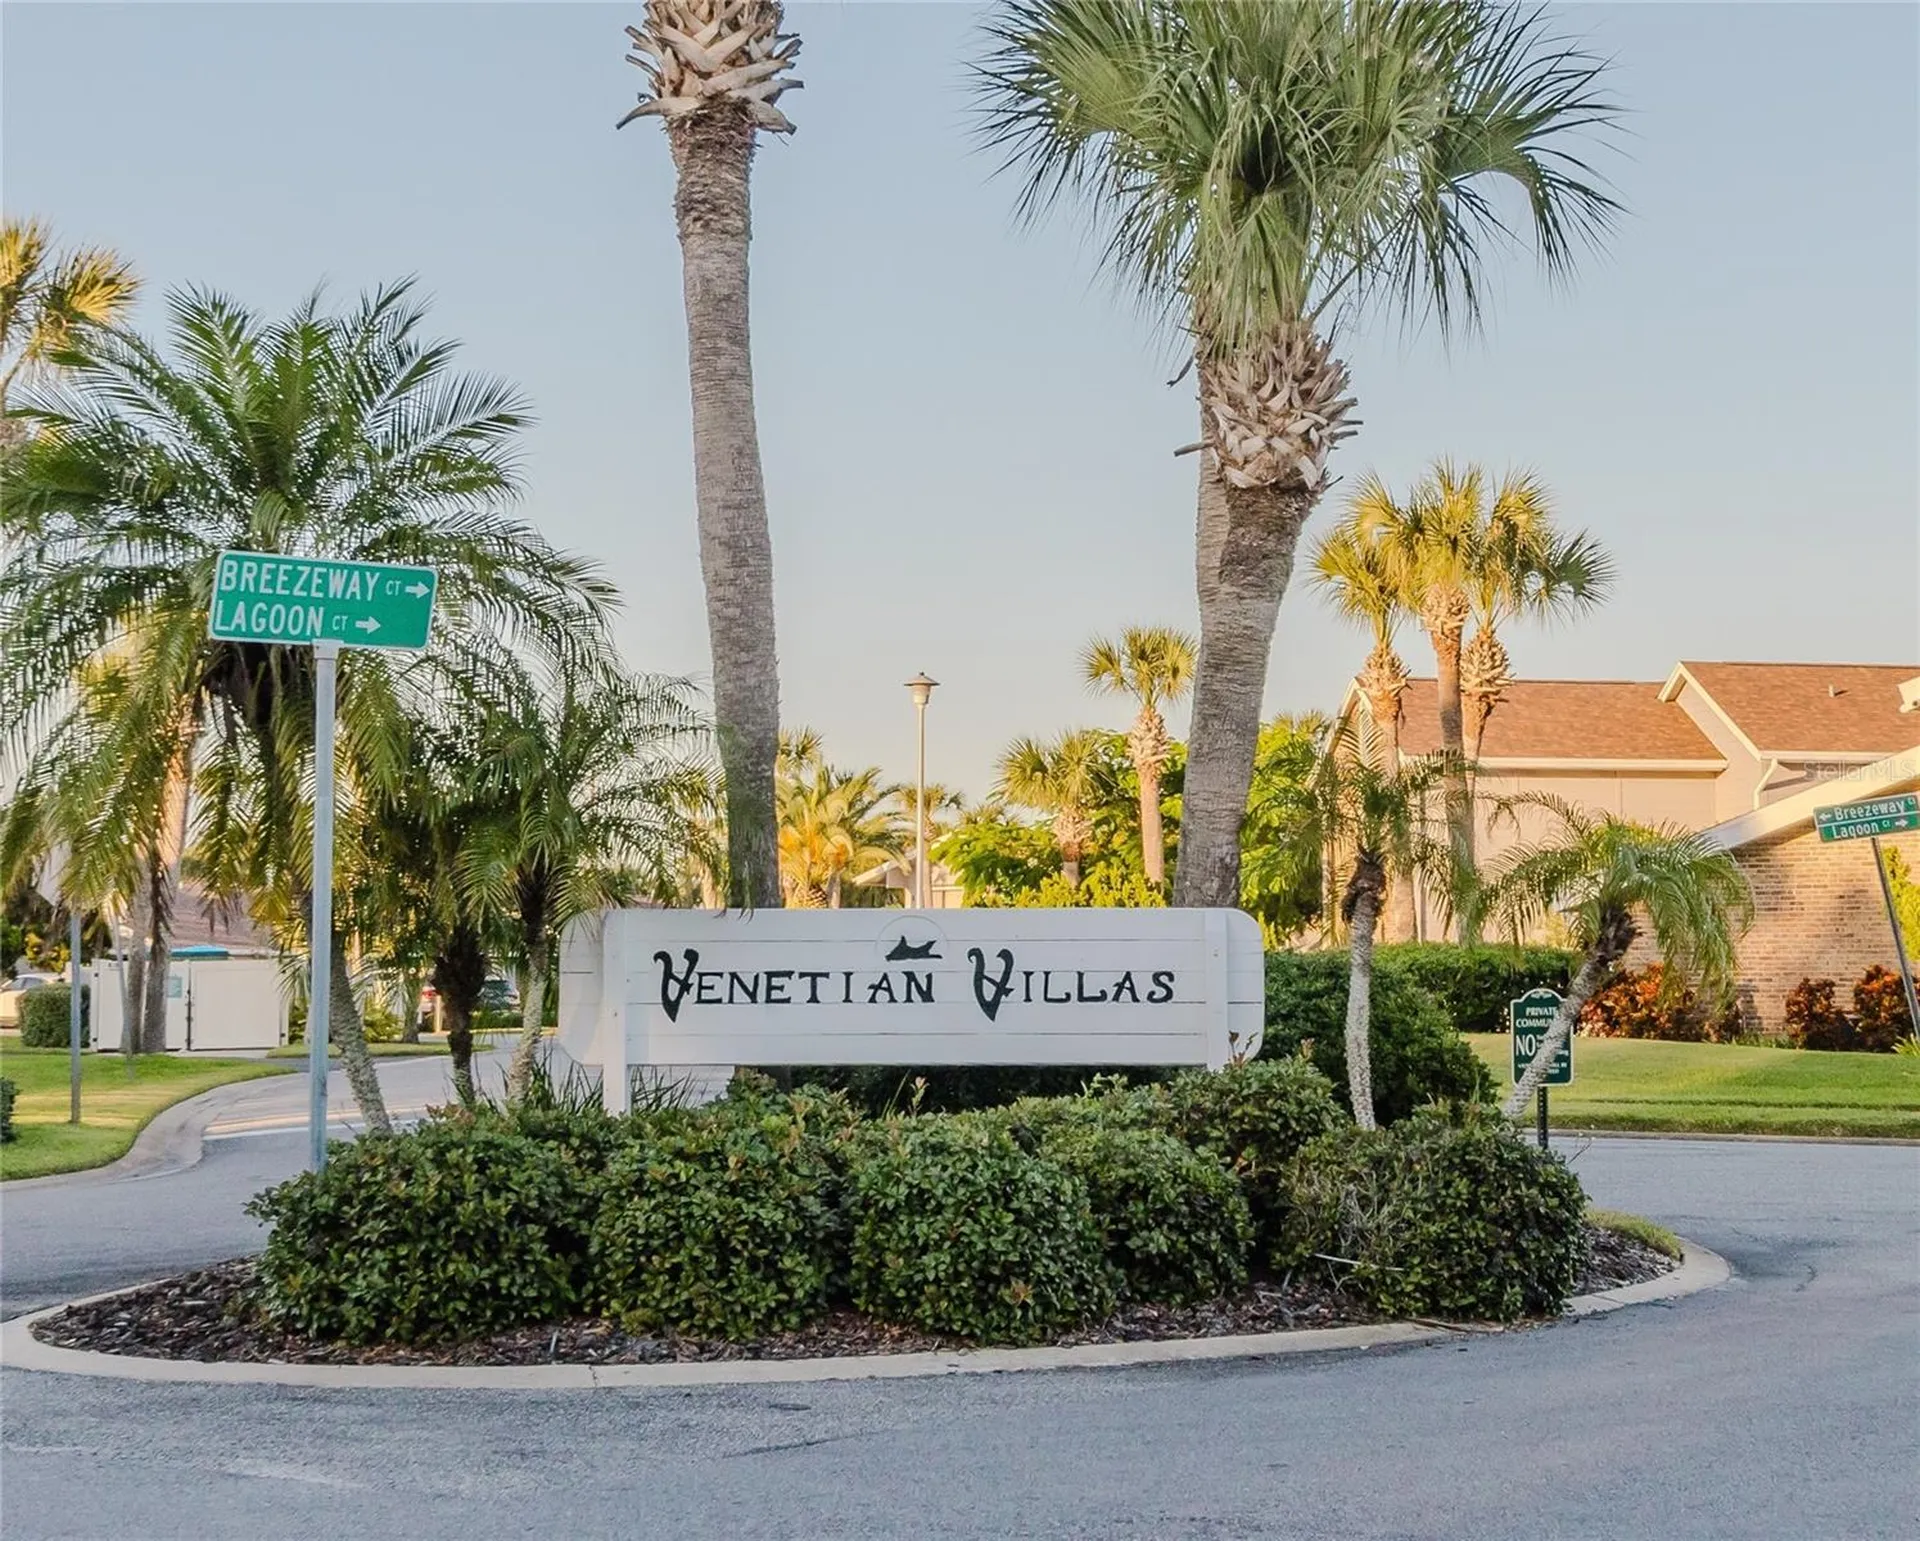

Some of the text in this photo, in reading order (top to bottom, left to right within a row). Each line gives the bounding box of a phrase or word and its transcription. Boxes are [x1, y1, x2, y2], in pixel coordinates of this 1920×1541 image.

[220, 559, 402, 601] BREEZEWAY CT
[214, 600, 349, 637] LAGOON CT
[1833, 799, 1905, 821] Breezeway
[1831, 822, 1881, 839] Lagoon
[653, 947, 1176, 1022] VENETIAN VILLAS
[1515, 1034, 1536, 1057] NO
